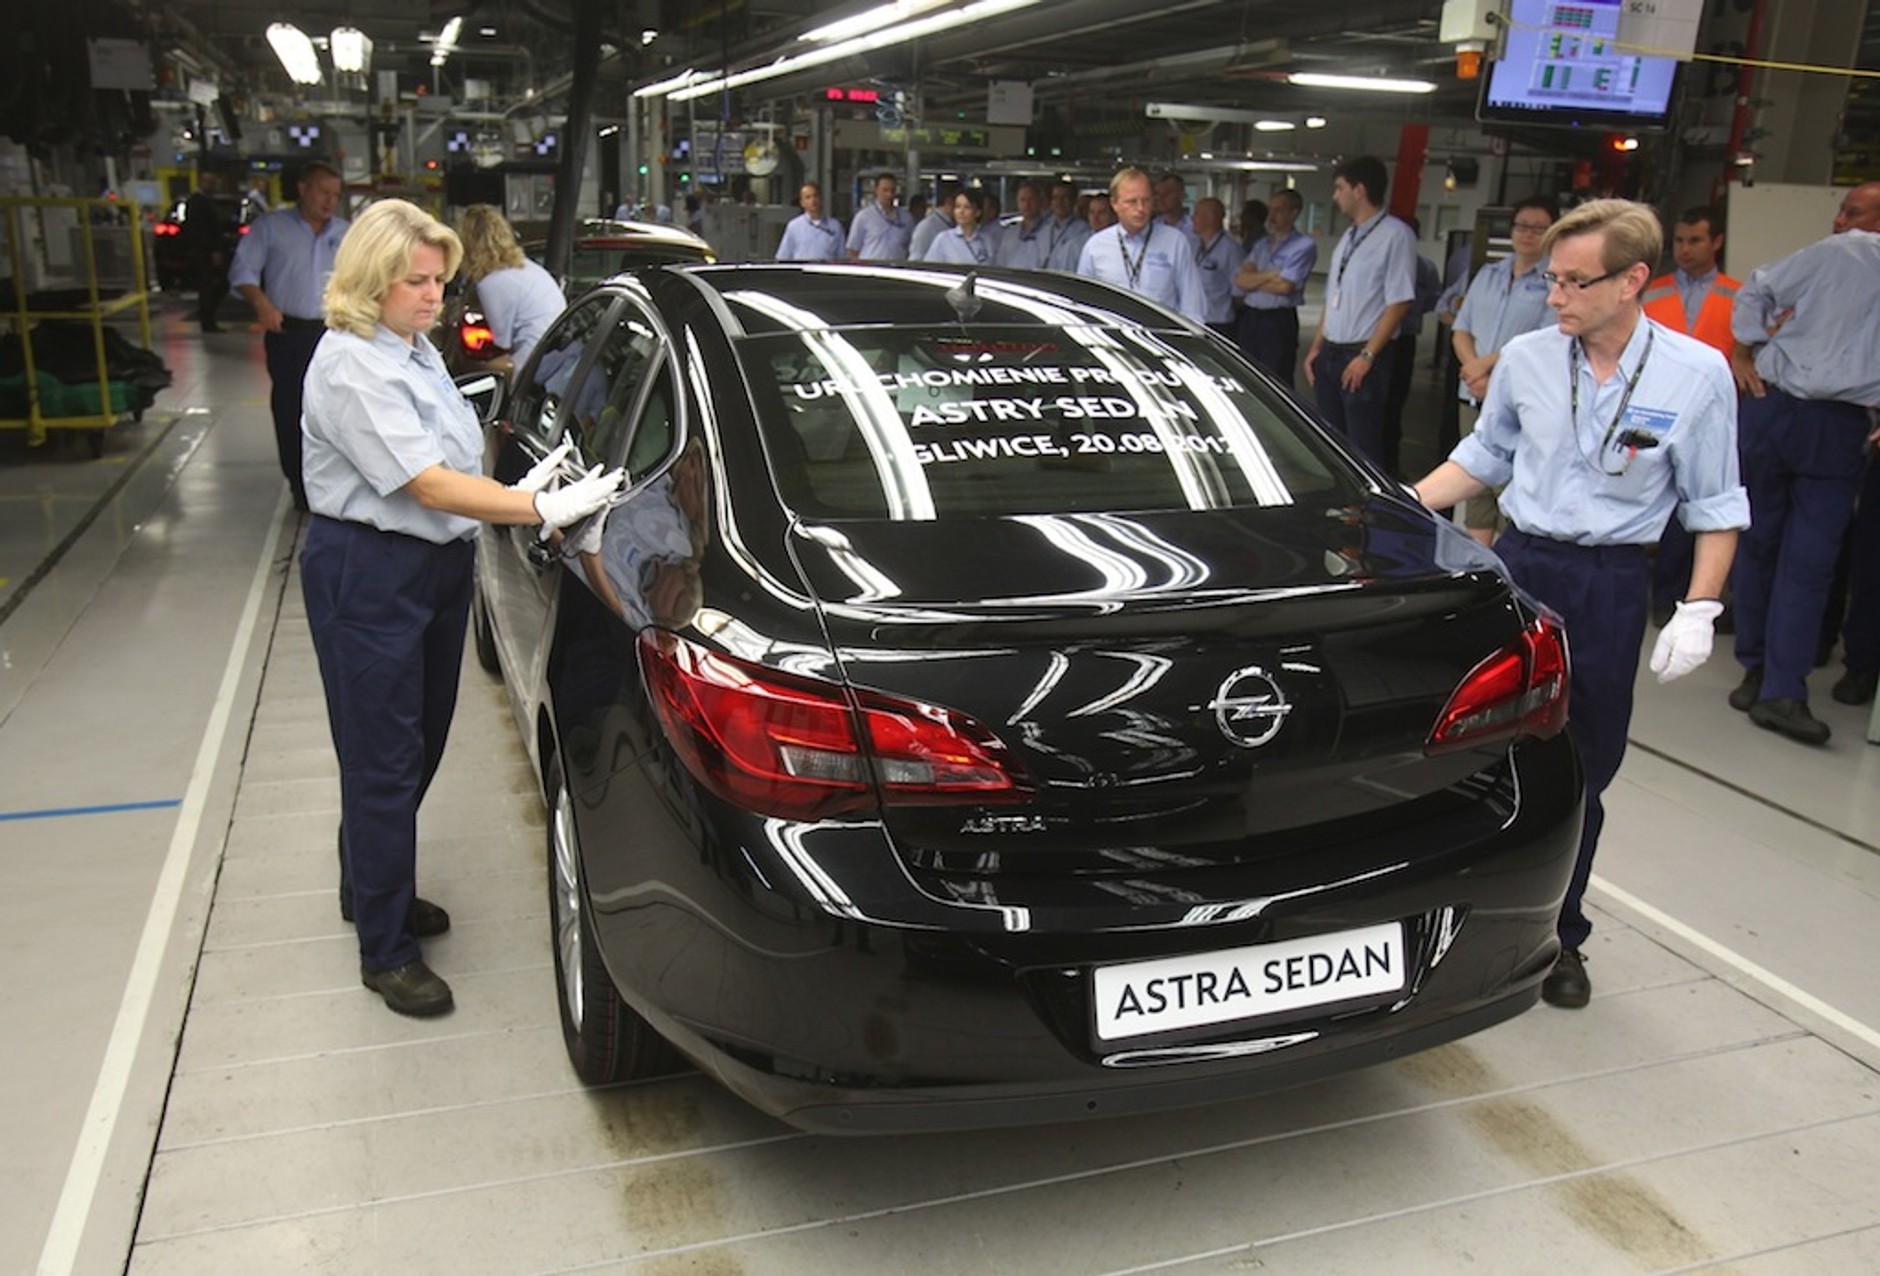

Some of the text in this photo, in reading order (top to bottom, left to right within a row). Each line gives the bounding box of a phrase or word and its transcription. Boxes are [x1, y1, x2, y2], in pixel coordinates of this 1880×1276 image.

[793, 367, 1244, 399] URCHOMIENIE PRDUJI
[911, 398, 1043, 427] ASTRY
[912, 433, 1240, 464] GLIWICE, 20.082012
[960, 817, 1047, 833] ASTRA
[1114, 941, 1391, 1020] ASTRA SEDAN
